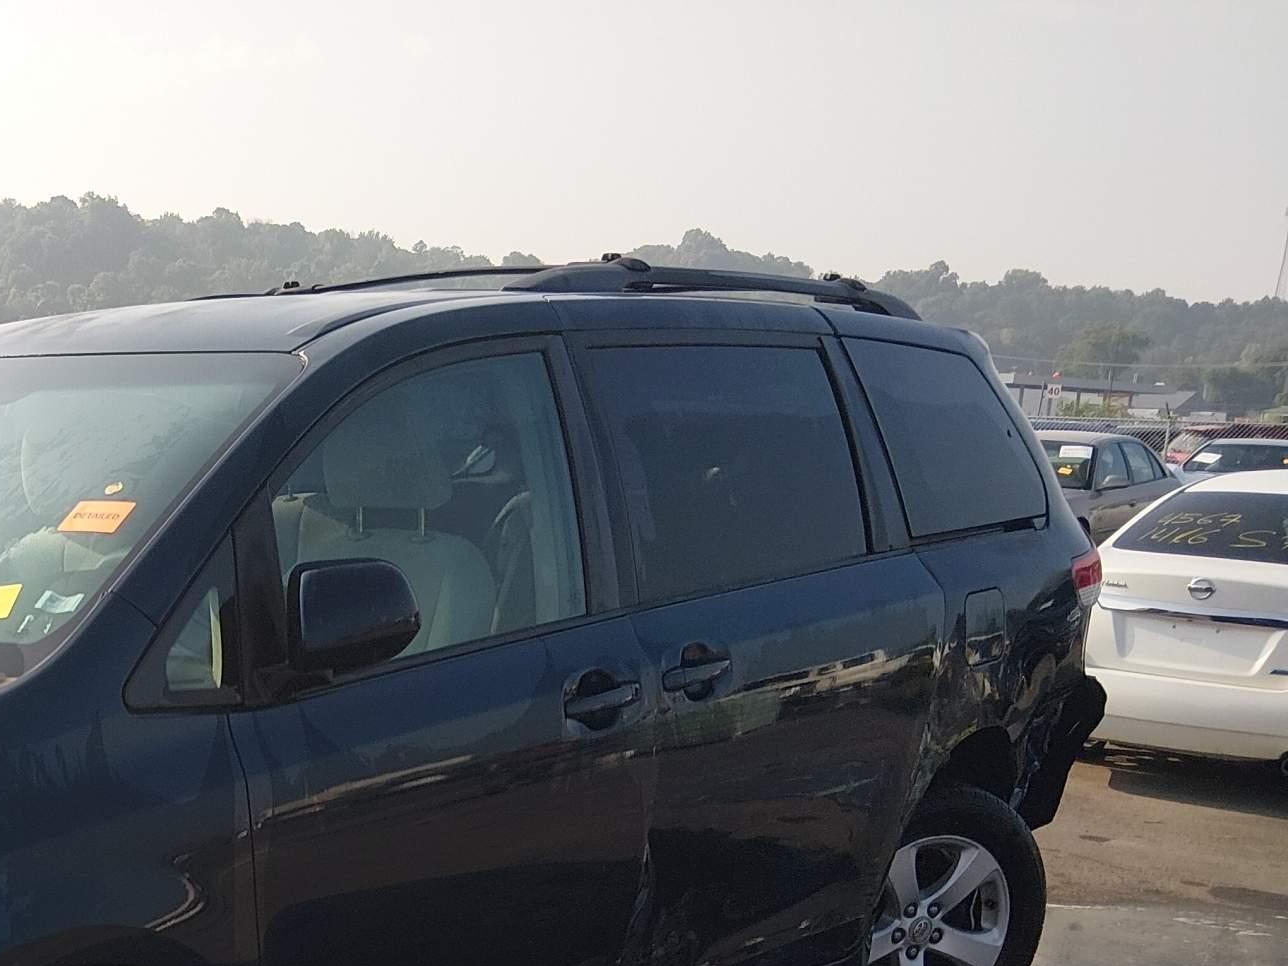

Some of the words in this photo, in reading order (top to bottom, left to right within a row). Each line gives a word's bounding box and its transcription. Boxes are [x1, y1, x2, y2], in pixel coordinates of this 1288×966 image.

[1048, 387, 1060, 396] 40
[73, 511, 120, 520] DETAILED
[1158, 512, 1242, 528] 4567
